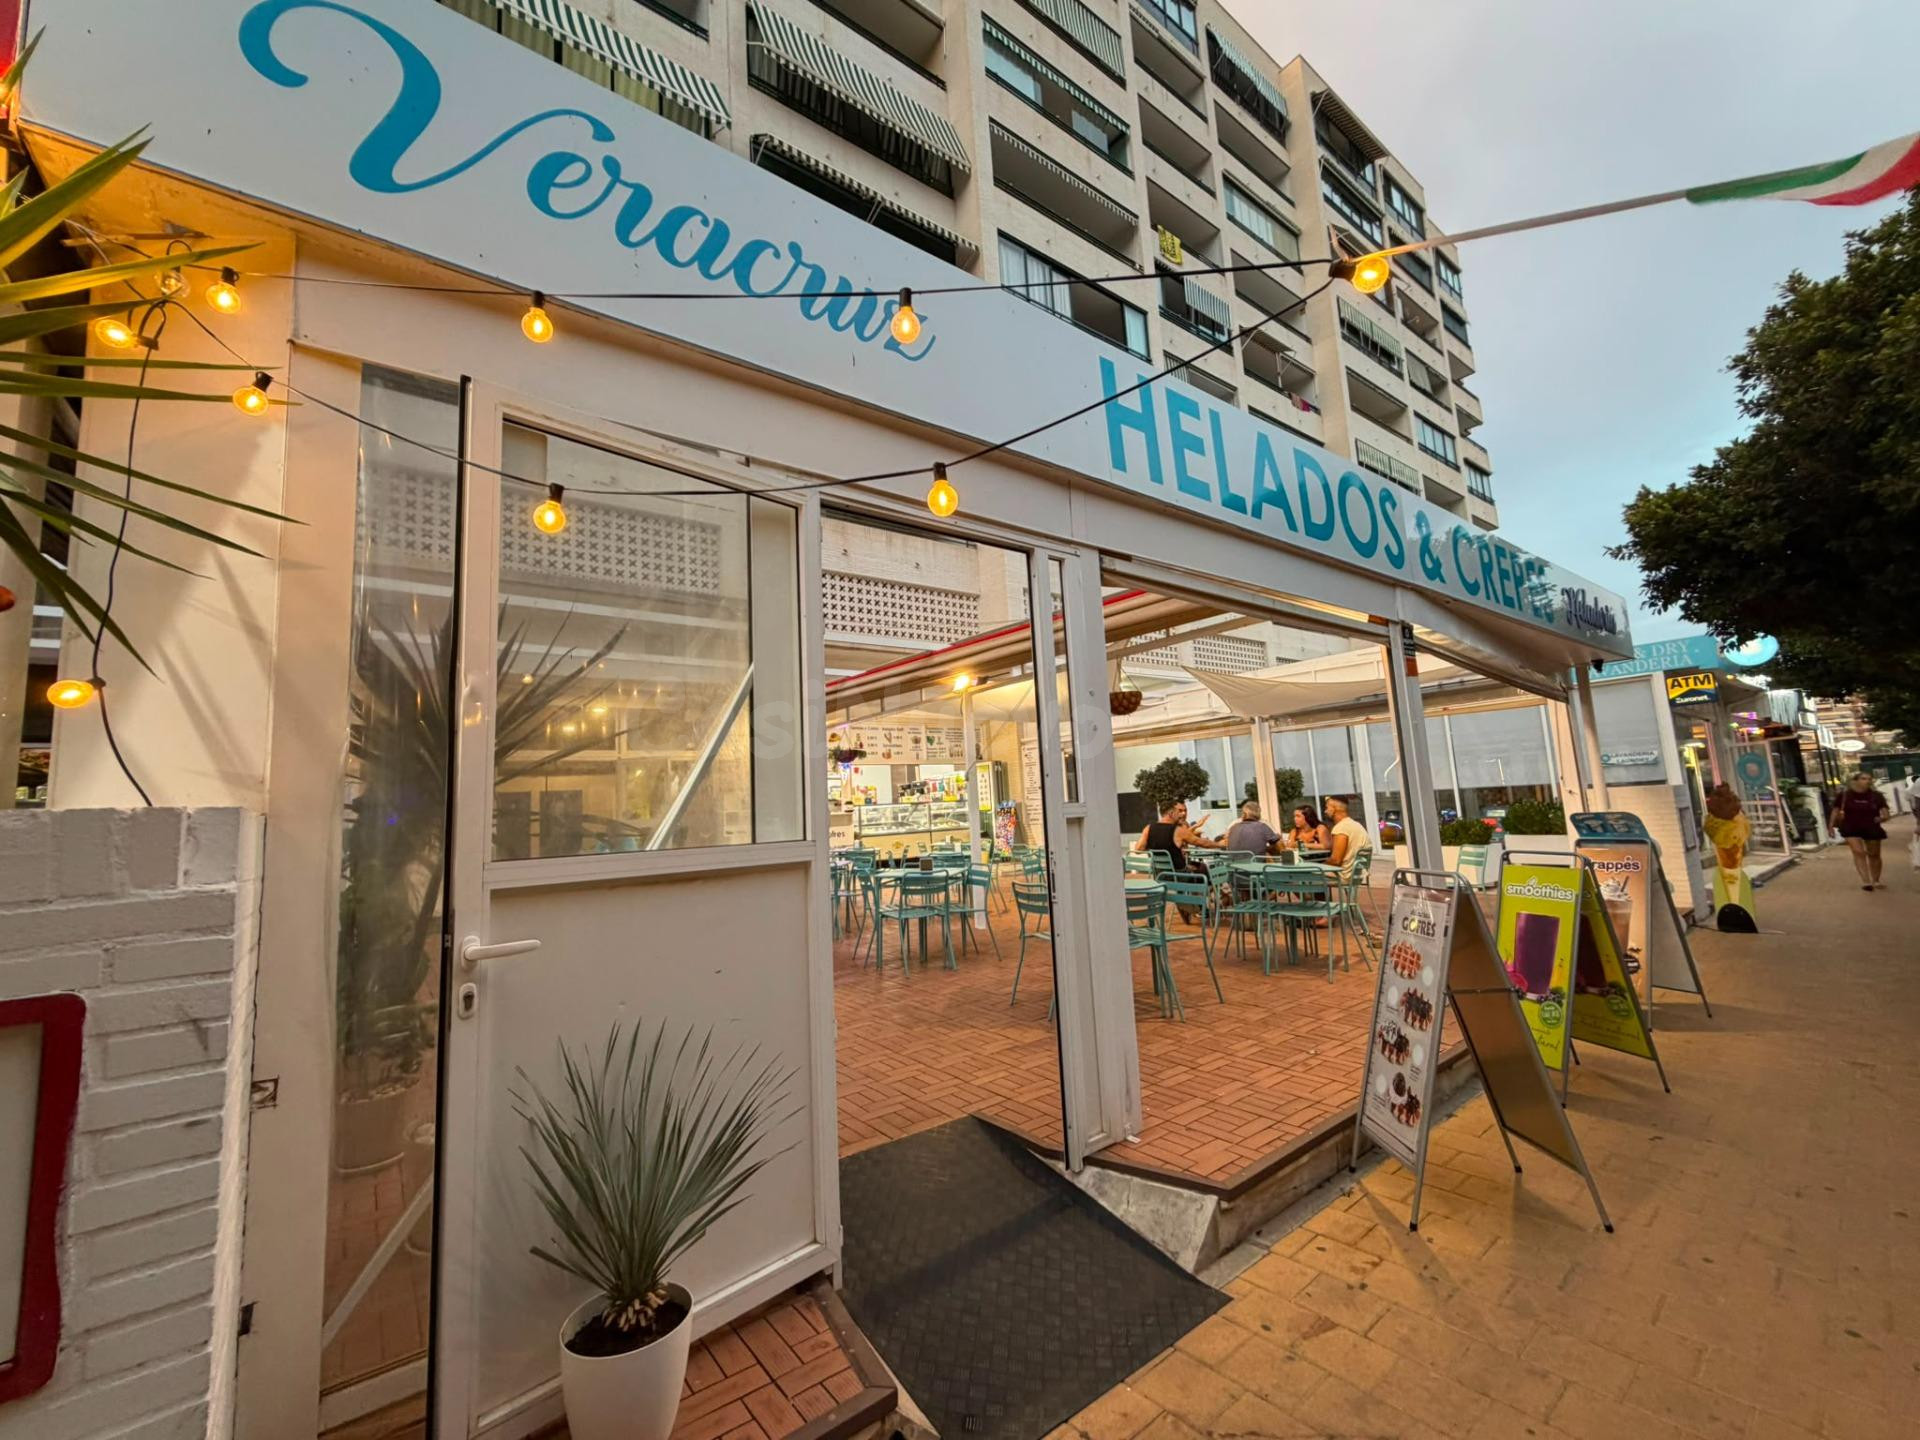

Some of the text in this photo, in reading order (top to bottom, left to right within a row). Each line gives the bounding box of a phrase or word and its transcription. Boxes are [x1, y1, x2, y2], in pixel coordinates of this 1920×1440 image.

[239, 0, 936, 362] Veracruz
[1099, 355, 1405, 571] HELADOS
[1415, 509, 1447, 585] &
[1652, 640, 1690, 657] DRY
[1590, 654, 1693, 679] AVANDERIA
[1670, 674, 1712, 690] ATM
[1506, 882, 1575, 901] smoothies
[1402, 916, 1437, 938] GOFRES
